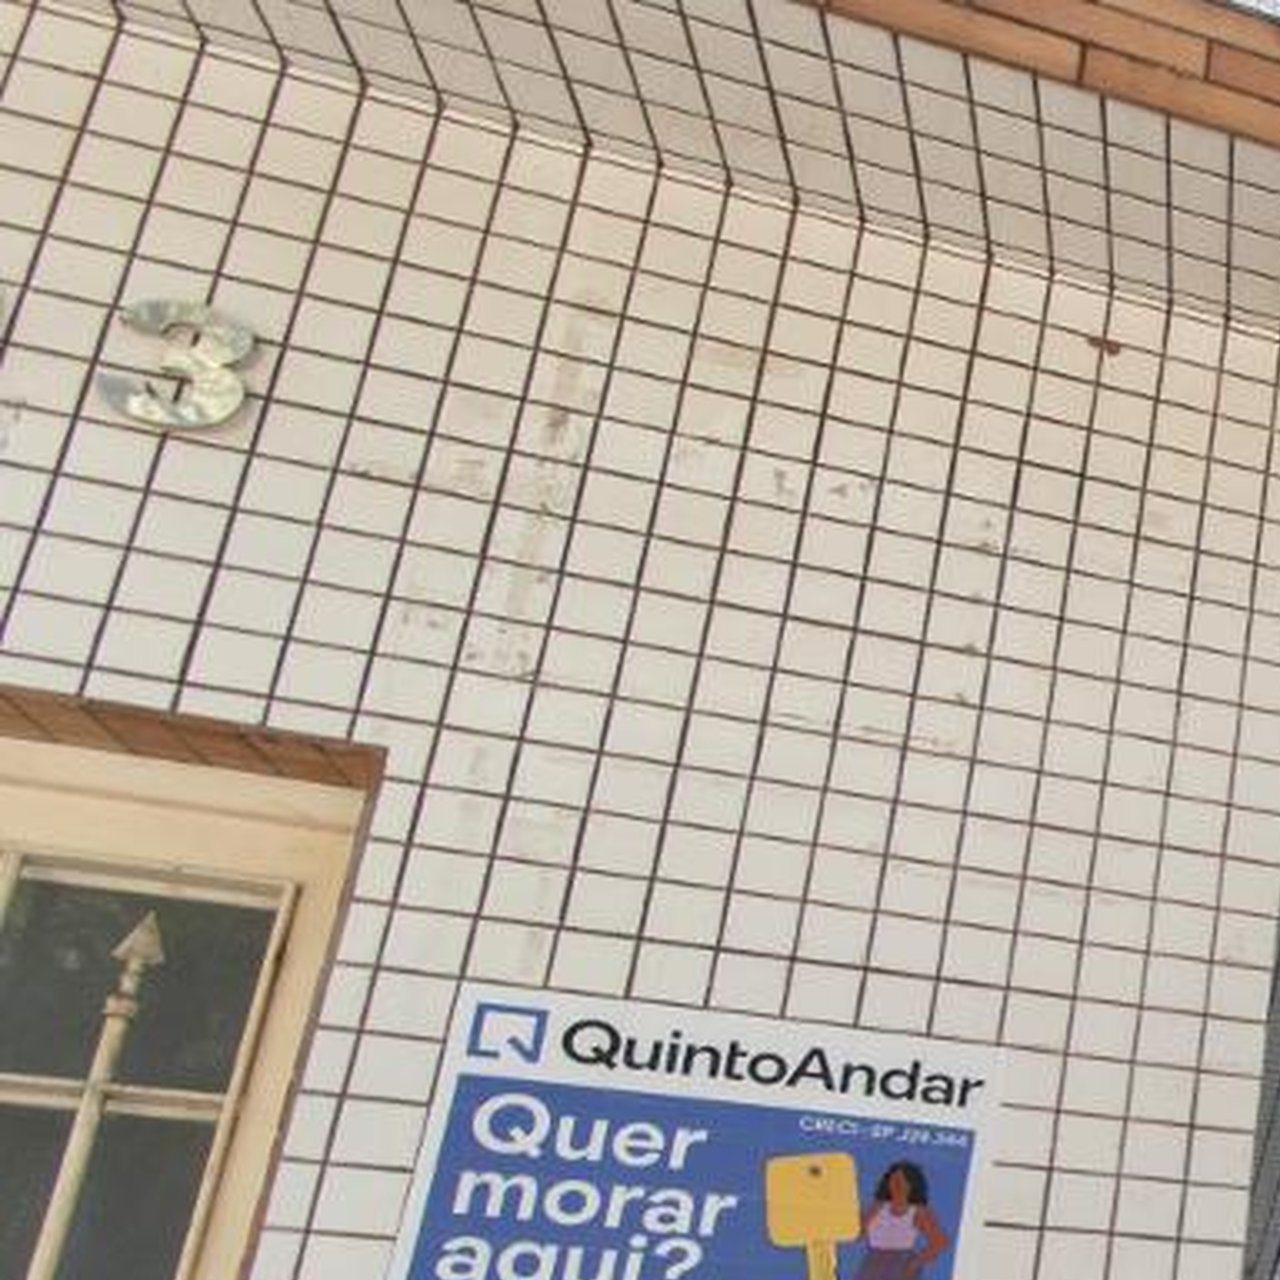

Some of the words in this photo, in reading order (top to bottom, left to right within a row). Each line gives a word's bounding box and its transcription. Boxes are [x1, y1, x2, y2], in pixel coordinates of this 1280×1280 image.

[98, 299, 256, 430] 3
[561, 1018, 986, 1108] QuintoAndar
[471, 1092, 708, 1171] Quer
[451, 1168, 738, 1238] morar
